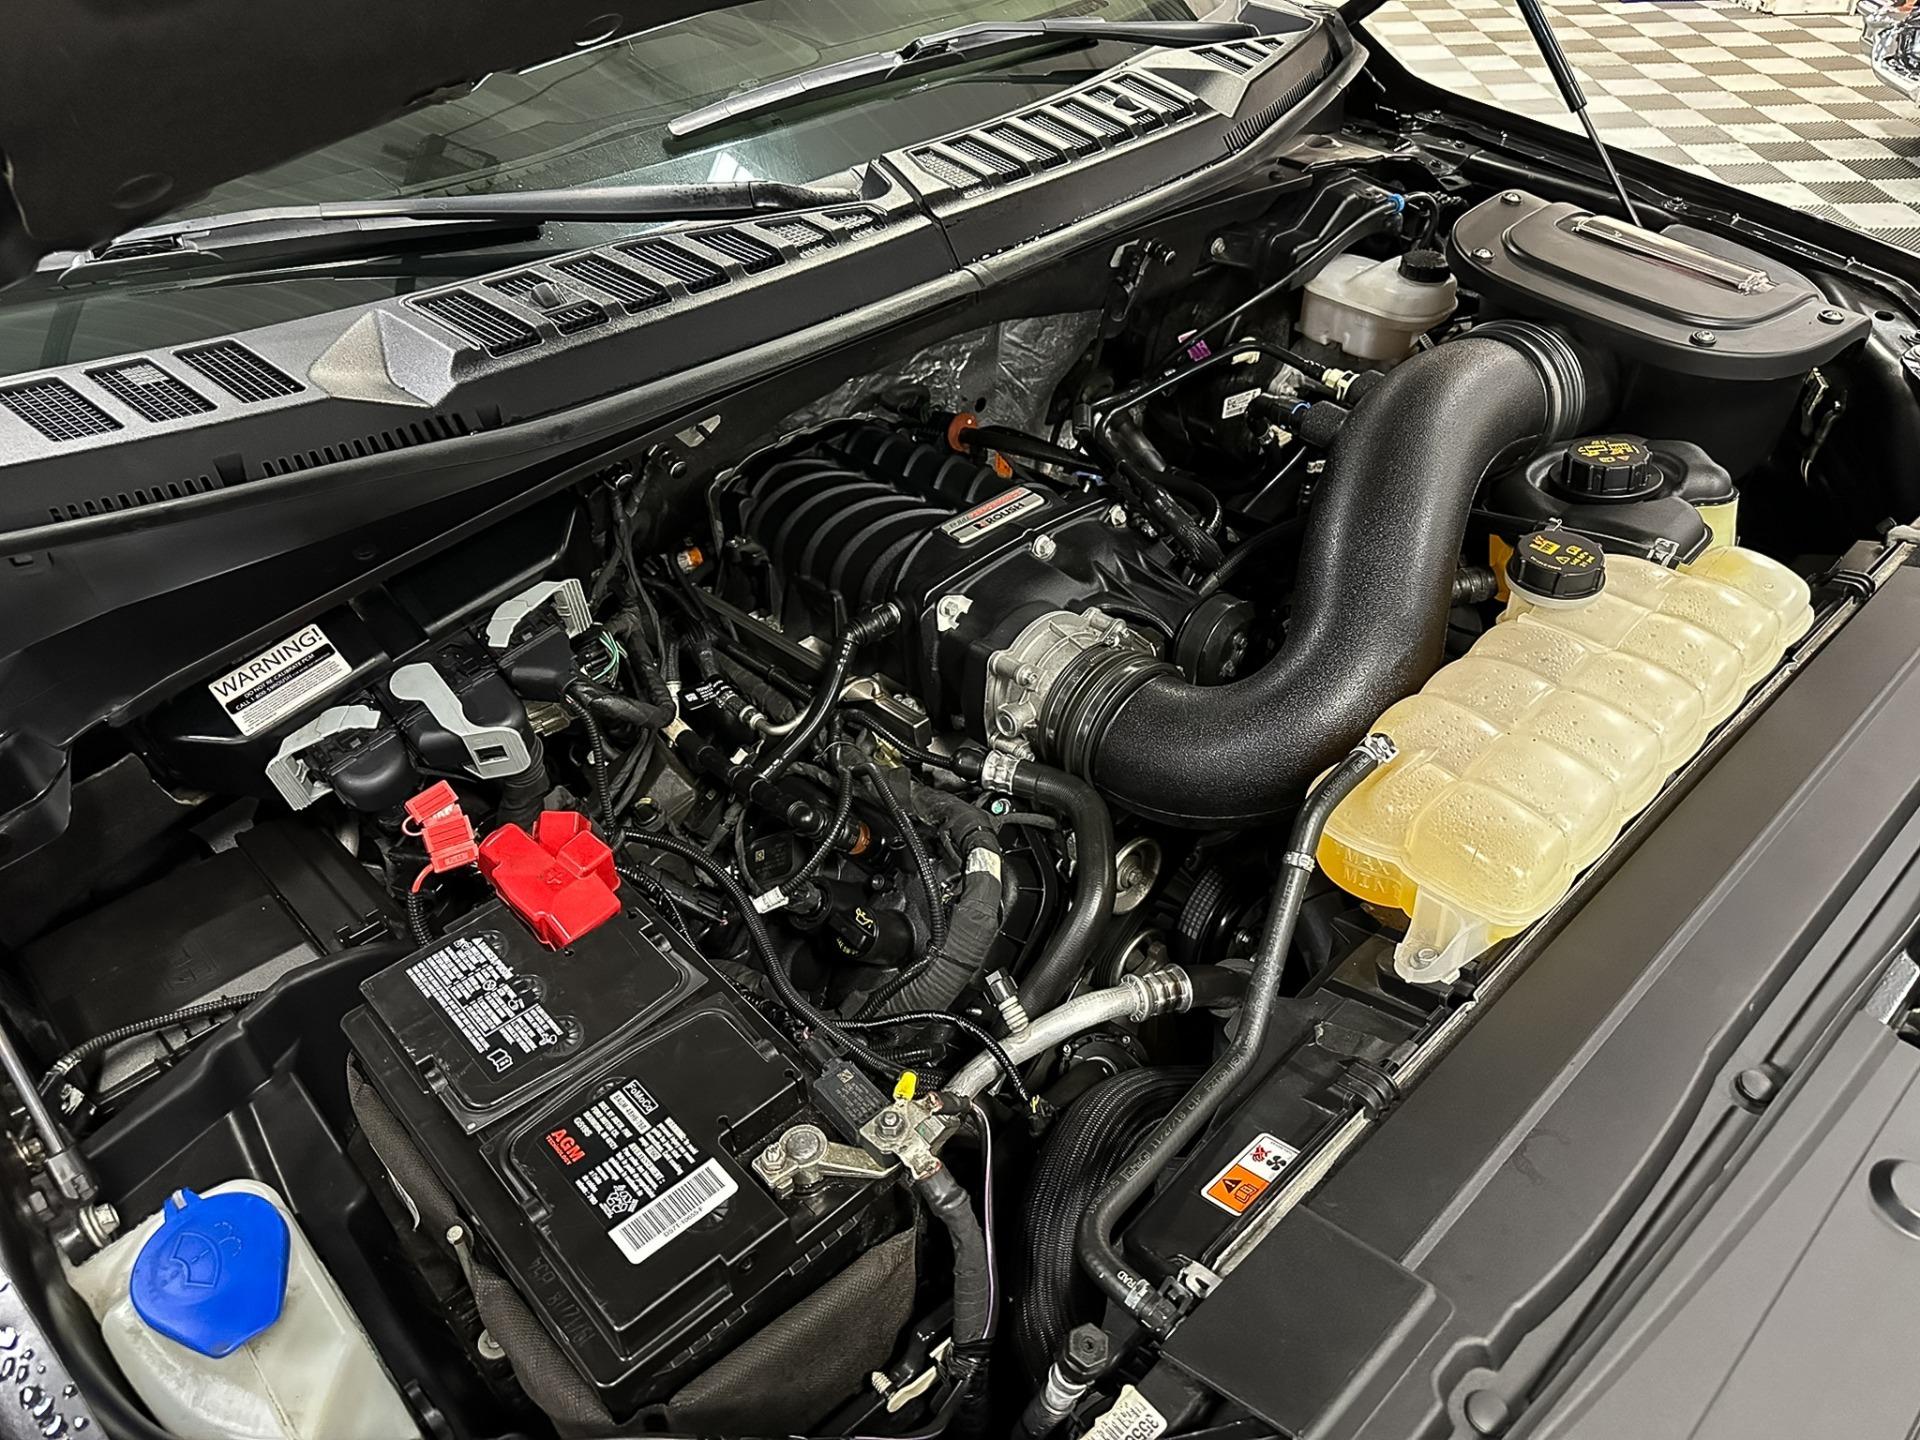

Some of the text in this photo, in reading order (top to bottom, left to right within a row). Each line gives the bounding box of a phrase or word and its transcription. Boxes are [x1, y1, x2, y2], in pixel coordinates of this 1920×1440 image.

[984, 502, 1026, 525] ROUSH
[214, 628, 323, 697] WARNING!
[243, 689, 254, 698] DO
[253, 682, 266, 693] NOT
[300, 652, 315, 663] PCM
[234, 698, 251, 711] CALL
[1343, 868, 1386, 894] MIN
[626, 1081, 654, 1113] FoMoCo
[545, 1134, 571, 1166] TECHNOLOGY
[550, 1124, 585, 1163] AGM
[1122, 1149, 1151, 1180] FoMoCo
[1115, 1268, 1137, 1288] RAD
